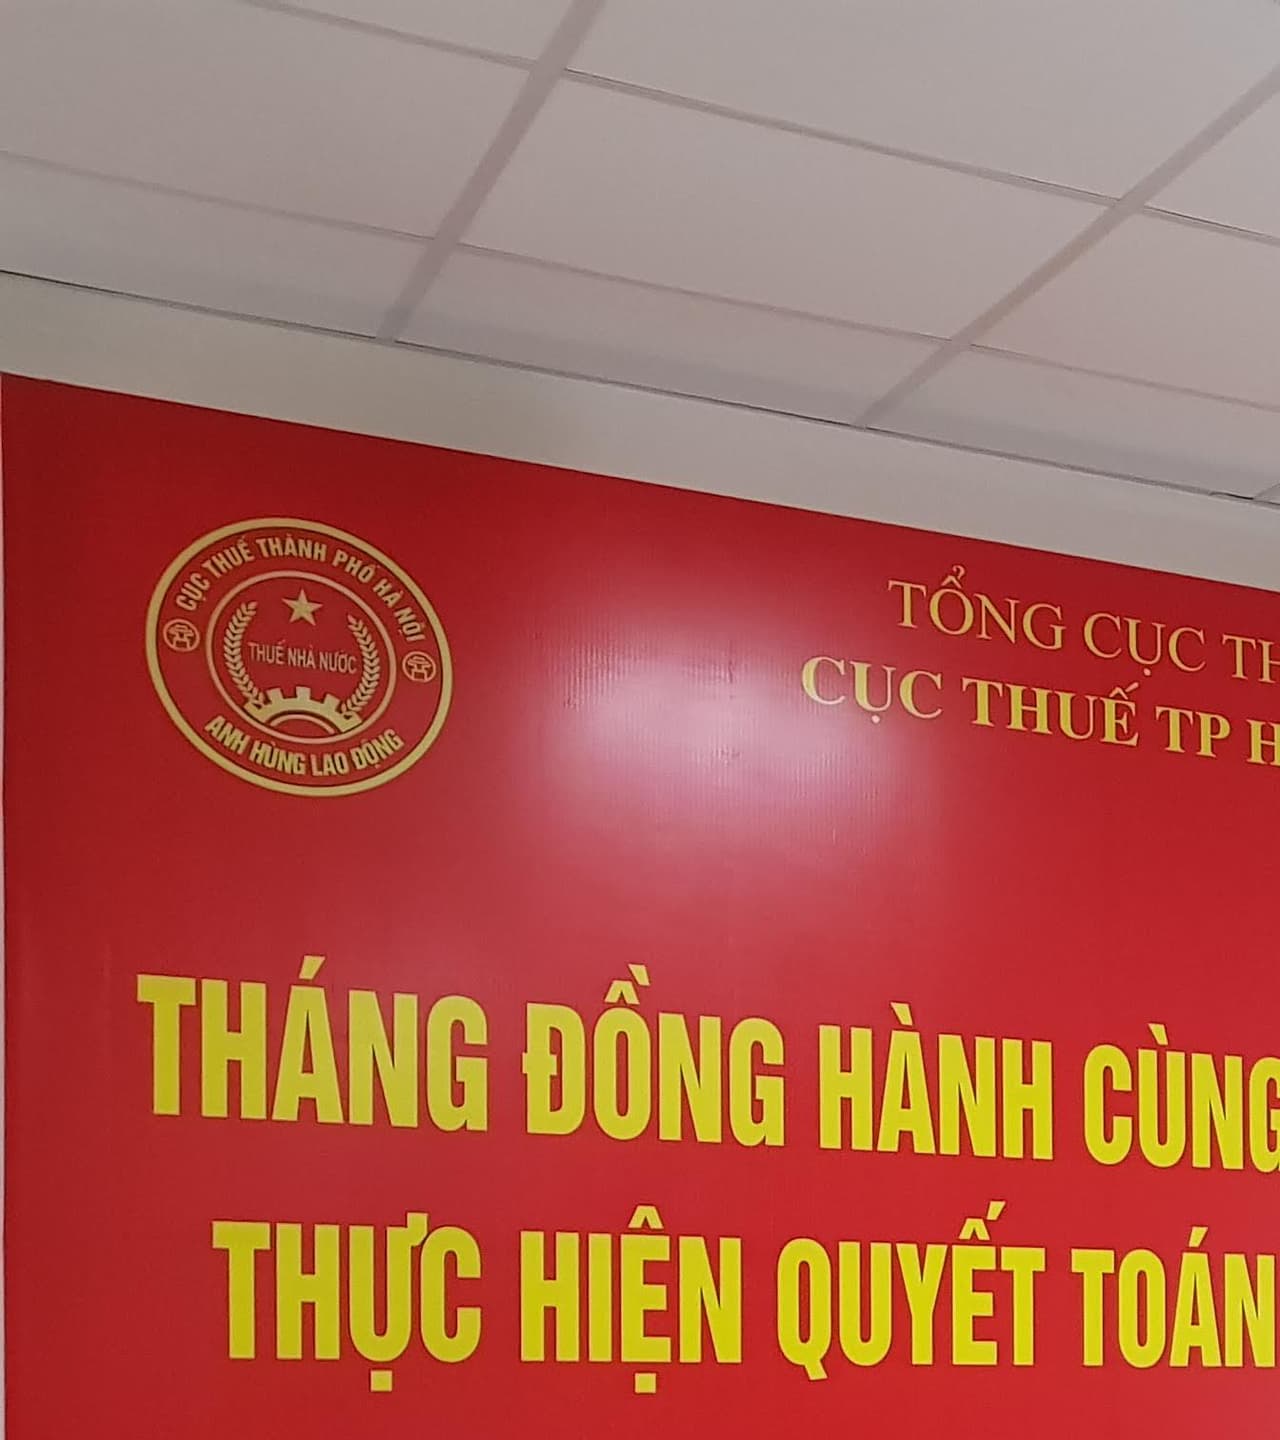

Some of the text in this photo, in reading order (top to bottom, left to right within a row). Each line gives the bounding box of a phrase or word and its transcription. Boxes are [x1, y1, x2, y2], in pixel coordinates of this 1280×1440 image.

[176, 533, 426, 642] CỤC THUẾ THÀNH PHỐ HÀ NỘI
[887, 565, 1067, 650] TỔNG
[1083, 611, 1206, 677] CỤC
[247, 639, 286, 665] THUẾ
[287, 644, 316, 669] NHÀ
[801, 655, 944, 723] CỤC
[961, 681, 1141, 747] THUẾ
[1155, 705, 1232, 759] TP
[204, 715, 405, 776] ANH HÙNG LAO ĐỘNG
[136, 956, 489, 1133] THÁNG
[521, 965, 787, 1147] ĐỒNG
[818, 1003, 1054, 1161] HÀNH
[211, 1212, 483, 1393] THỰC
[520, 1206, 743, 1394] HIỆN
[777, 1200, 1047, 1382] QUYẾT
[1070, 1226, 1277, 1370] TOÁN
